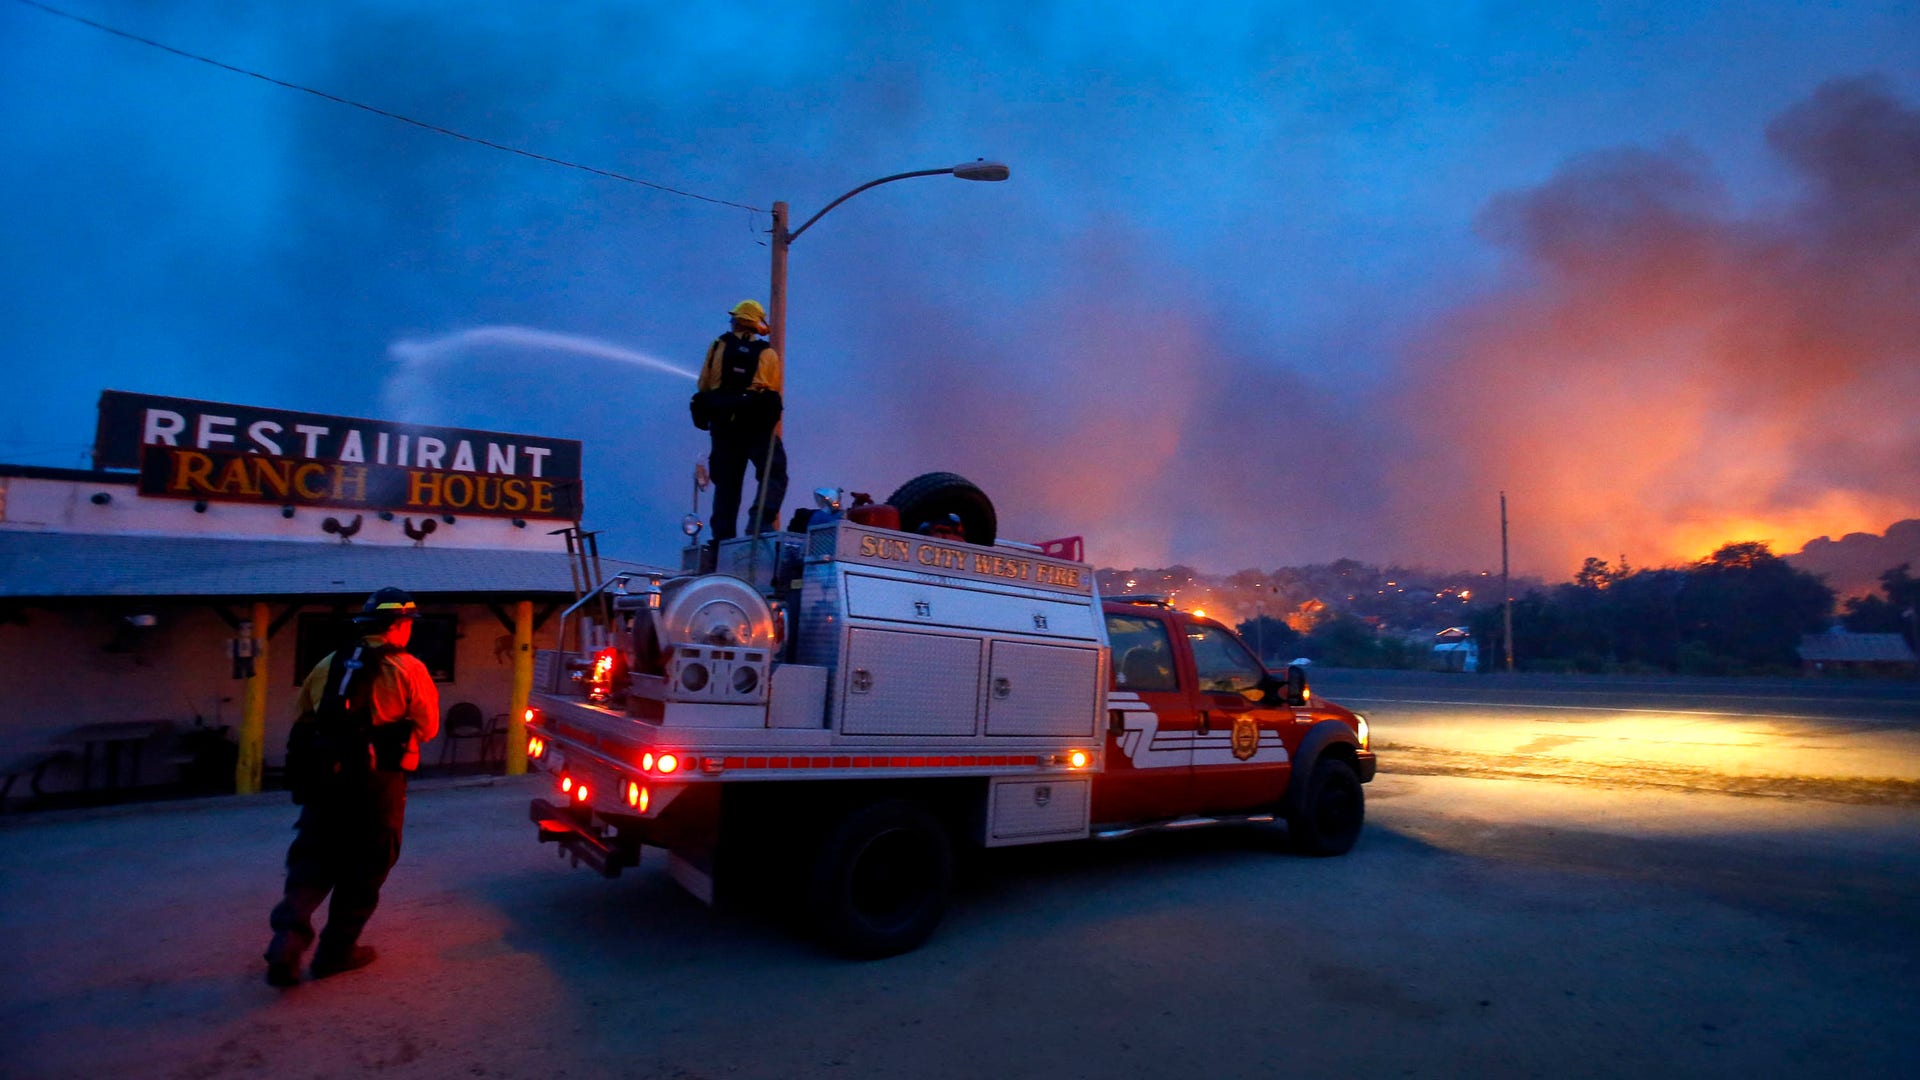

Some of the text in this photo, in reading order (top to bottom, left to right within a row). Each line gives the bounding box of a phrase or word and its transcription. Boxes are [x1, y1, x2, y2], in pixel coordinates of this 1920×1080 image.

[143, 408, 552, 477] RESTAURANT
[173, 450, 555, 513] RANCH HOUSE
[861, 535, 1080, 588] SUN CITY WEST FIRE
